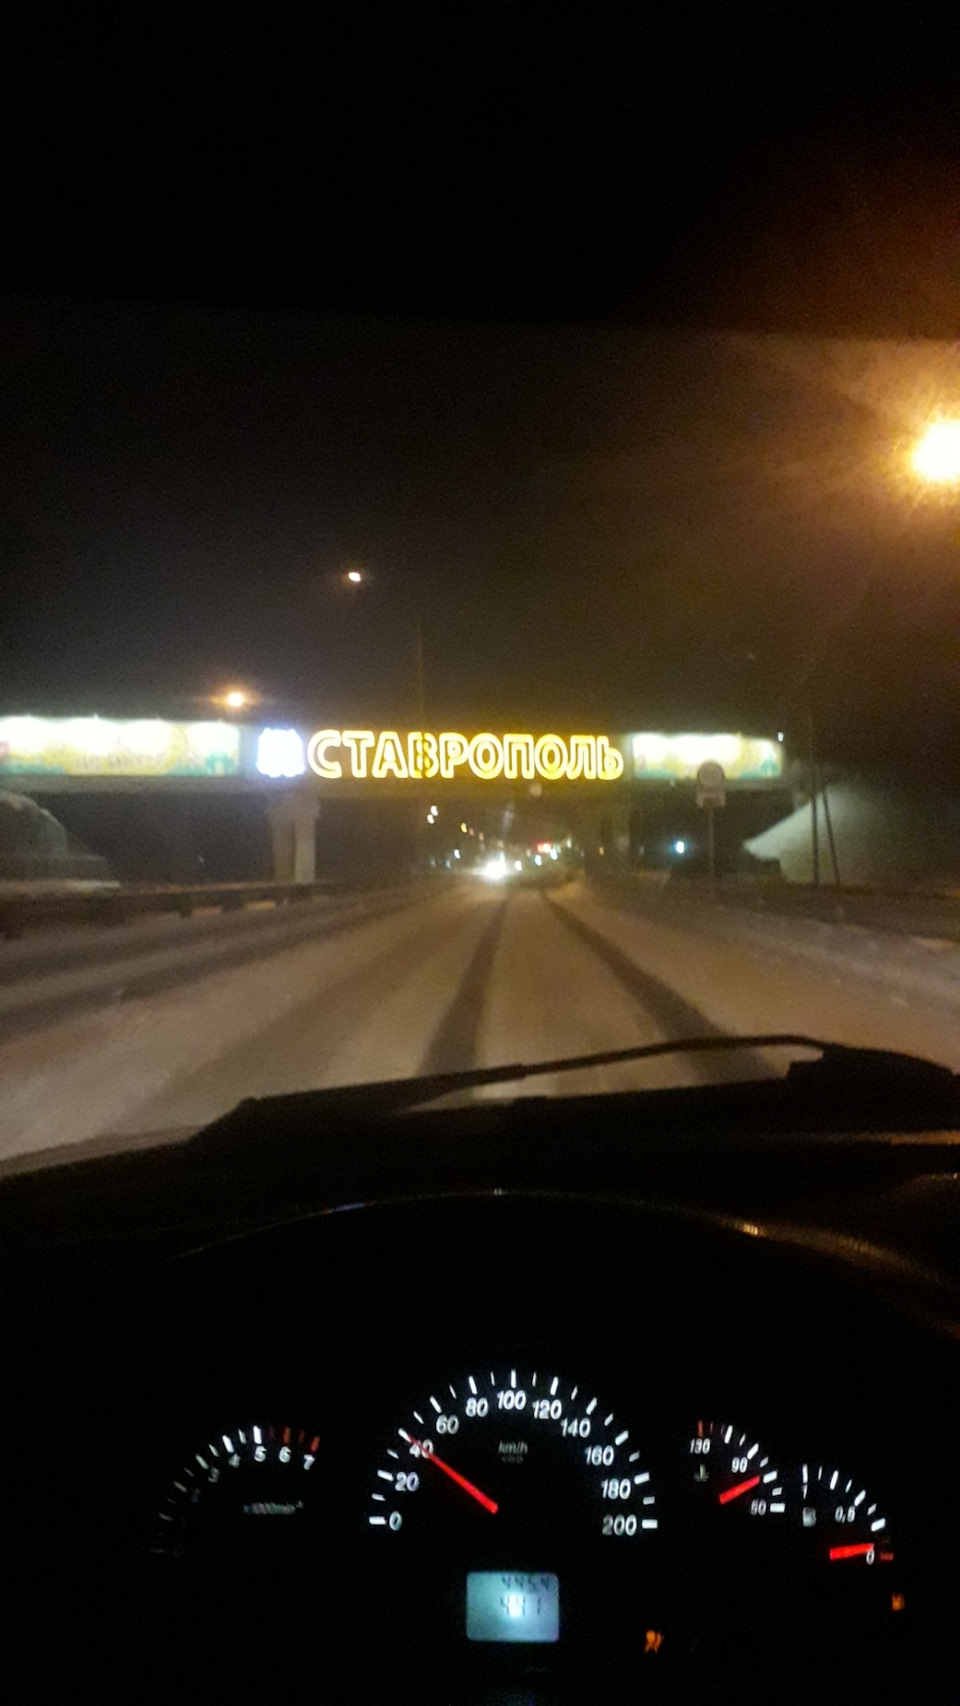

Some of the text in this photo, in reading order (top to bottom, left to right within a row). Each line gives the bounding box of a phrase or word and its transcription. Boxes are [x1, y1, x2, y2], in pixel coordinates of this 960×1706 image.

[307, 729, 624, 780] СТАВРОПОЛЬ
[466, 1398, 488, 1418] 80
[497, 1390, 526, 1410] 100
[533, 1400, 562, 1420] 120
[436, 1415, 459, 1434] 60
[561, 1417, 590, 1438] 140
[253, 1445, 267, 1463] 5
[278, 1445, 291, 1464] 6
[409, 1439, 434, 1459] 40
[498, 1441, 529, 1455] km/h
[585, 1445, 614, 1466] 160
[690, 1438, 710, 1454] 130
[303, 1453, 315, 1471] 7
[732, 1457, 748, 1473] 90
[395, 1472, 419, 1492] 20
[601, 1478, 631, 1500] 180
[389, 1511, 402, 1531] 0
[602, 1515, 637, 1536] 200
[866, 1550, 875, 1565] 0
